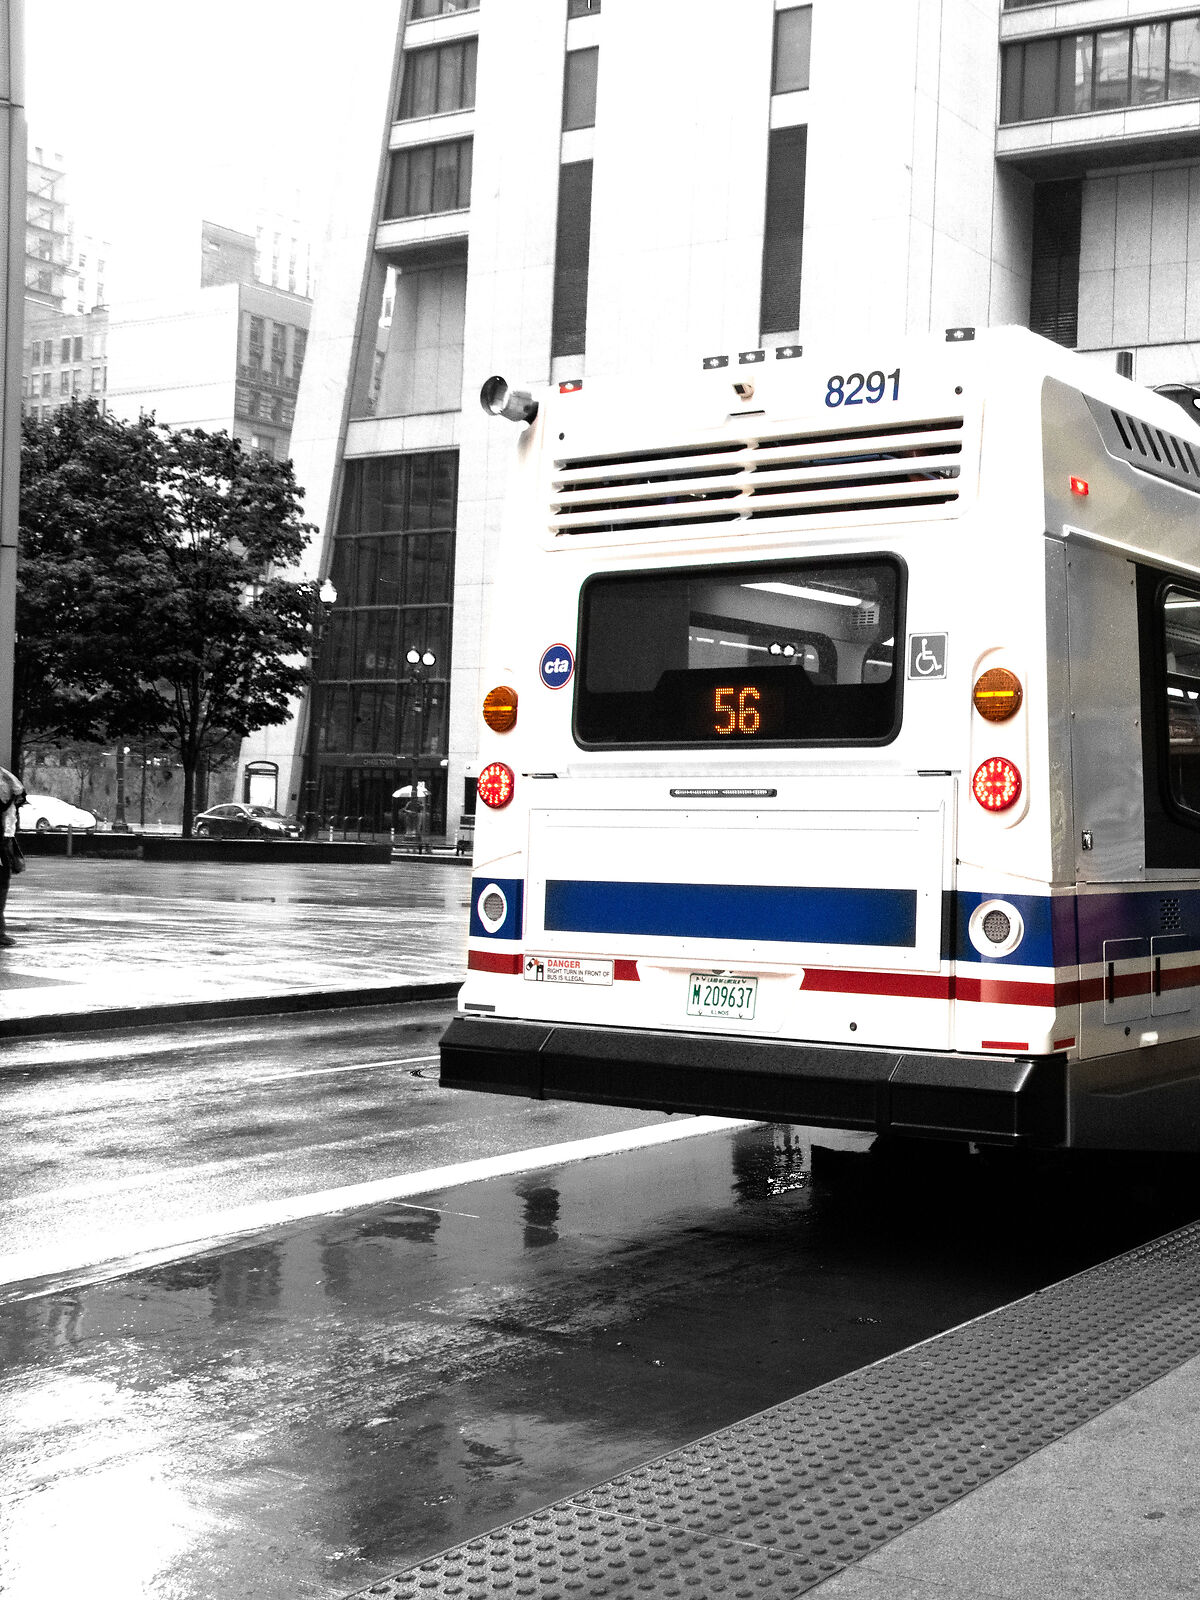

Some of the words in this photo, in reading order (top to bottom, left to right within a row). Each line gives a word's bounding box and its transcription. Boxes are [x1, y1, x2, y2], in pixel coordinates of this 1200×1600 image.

[825, 368, 900, 408] 8291
[544, 658, 569, 674] cta
[715, 687, 760, 735] 56
[547, 959, 581, 968] DANGER
[564, 974, 585, 982] ILLEGAL
[703, 985, 753, 1009] 209637
